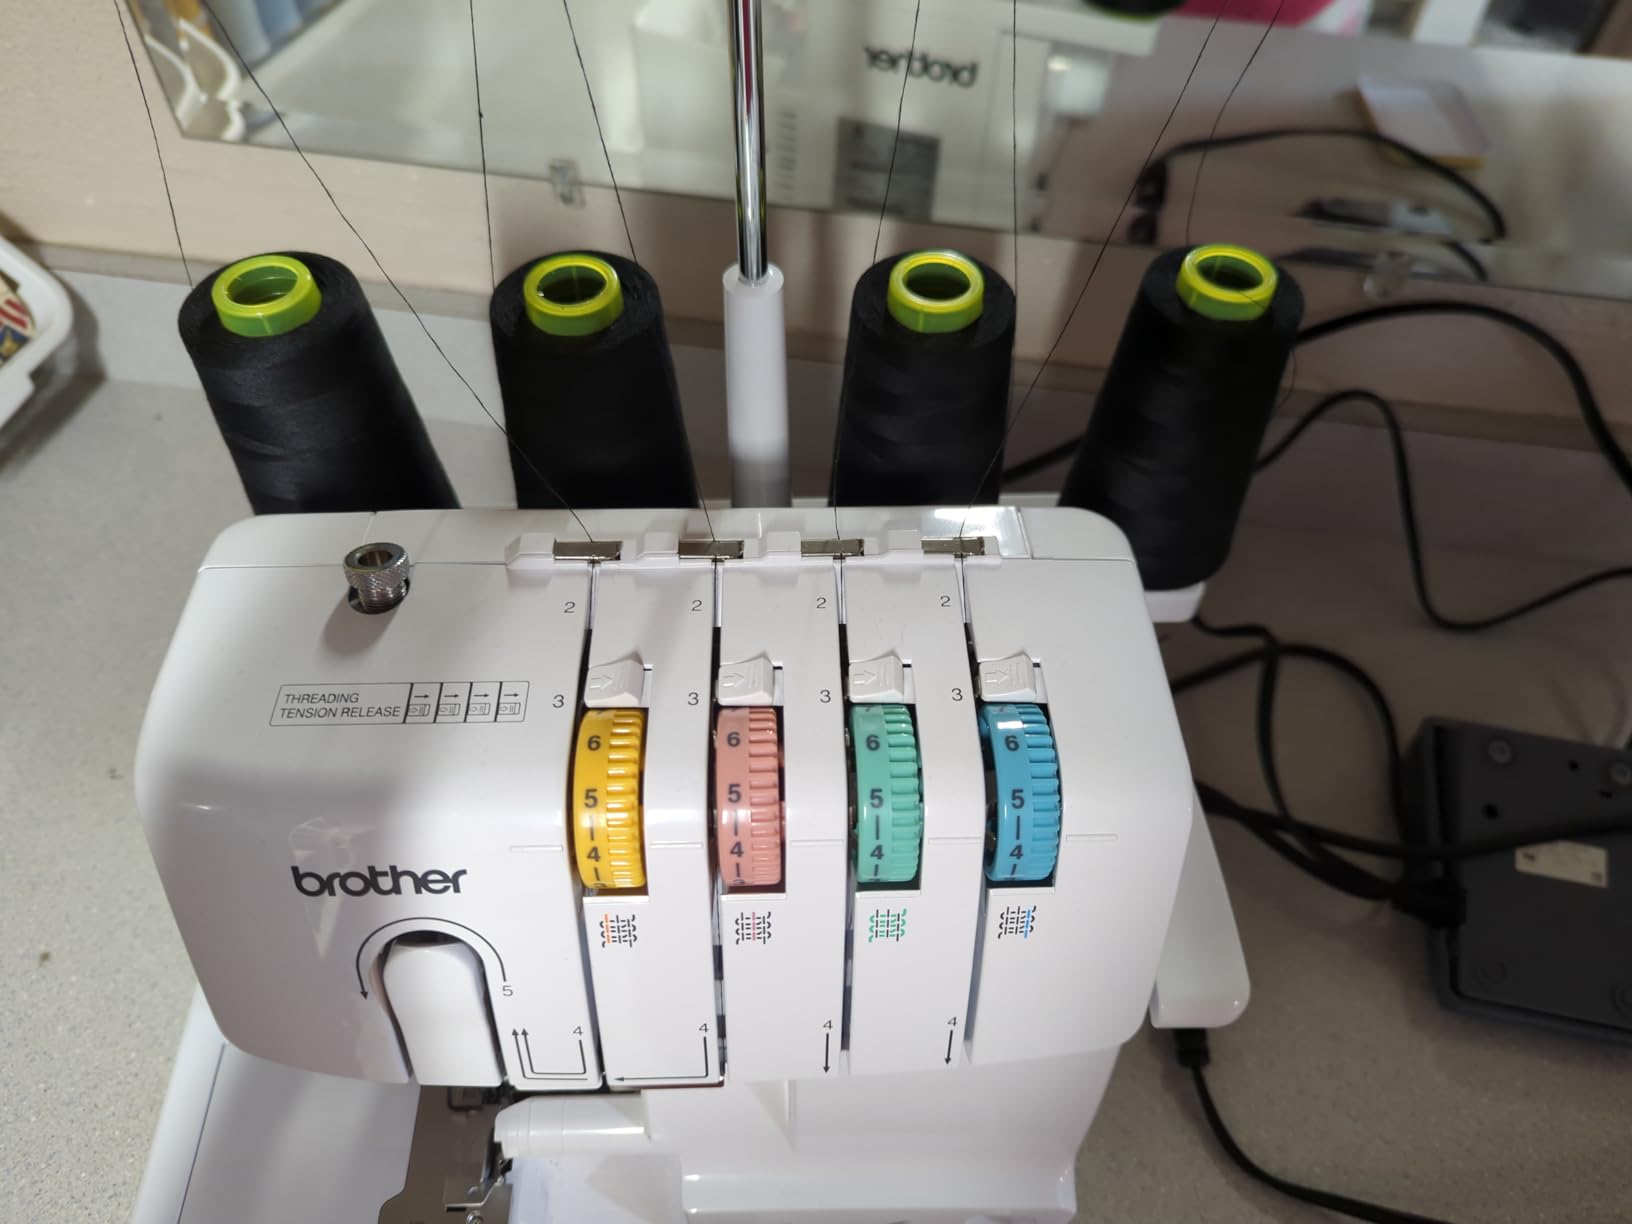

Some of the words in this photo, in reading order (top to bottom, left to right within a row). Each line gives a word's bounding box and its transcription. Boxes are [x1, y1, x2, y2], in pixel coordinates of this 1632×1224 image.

[563, 601, 576, 614] 2
[691, 599, 703, 612] 2
[816, 597, 828, 609] 2
[940, 595, 952, 607] 2
[284, 692, 360, 704] THREADING
[552, 694, 565, 709] 3
[687, 692, 699, 706] 3
[820, 689, 832, 704] 3
[951, 687, 964, 702] 3
[279, 706, 337, 719] TENSION
[339, 705, 400, 718] RELEASE
[587, 734, 602, 752] 6
[726, 731, 741, 748] 6
[865, 734, 881, 752] 6
[1004, 734, 1020, 752] 6
[584, 788, 599, 809] 5
[727, 783, 742, 804] 5
[869, 787, 884, 809] 5
[1011, 788, 1025, 810] 5
[586, 845, 601, 863] 4
[729, 841, 745, 858] 4
[869, 844, 885, 861] 4
[1008, 844, 1024, 860] 4
[290, 864, 468, 898] brother
[502, 985, 514, 997] 5
[698, 1022, 709, 1034] 4
[823, 1019, 833, 1030] 4
[947, 1016, 957, 1027] 4
[572, 1025, 584, 1036] 4
